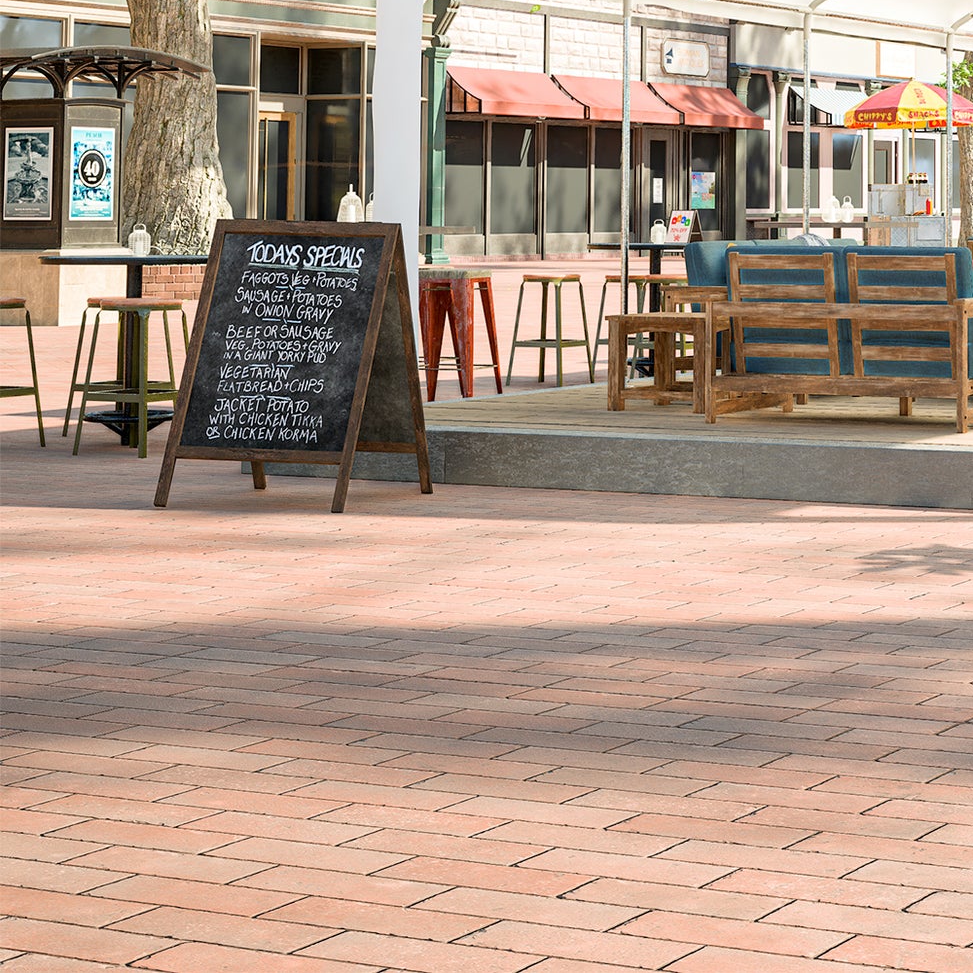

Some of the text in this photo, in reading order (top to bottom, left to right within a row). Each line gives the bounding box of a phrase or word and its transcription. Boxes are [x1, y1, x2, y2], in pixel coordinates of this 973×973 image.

[83, 160, 100, 176] 40
[247, 240, 365, 269] TODAYS SPECIALS
[241, 270, 289, 287] FAGGOTS
[291, 270, 311, 287] VEG
[255, 303, 294, 318] ONION
[296, 306, 335, 324] GRAVY
[225, 324, 334, 340] BEEF OR SAUSAGE
[244, 349, 274, 361] GIANT
[307, 352, 327, 364] PUD
[220, 363, 290, 381] VEGETARIAN
[214, 398, 309, 414] JACKET POTATO
[209, 412, 323, 429] WITH CHICKEN TIKKA
[205, 425, 318, 443] OR CHICKEN KORMA
